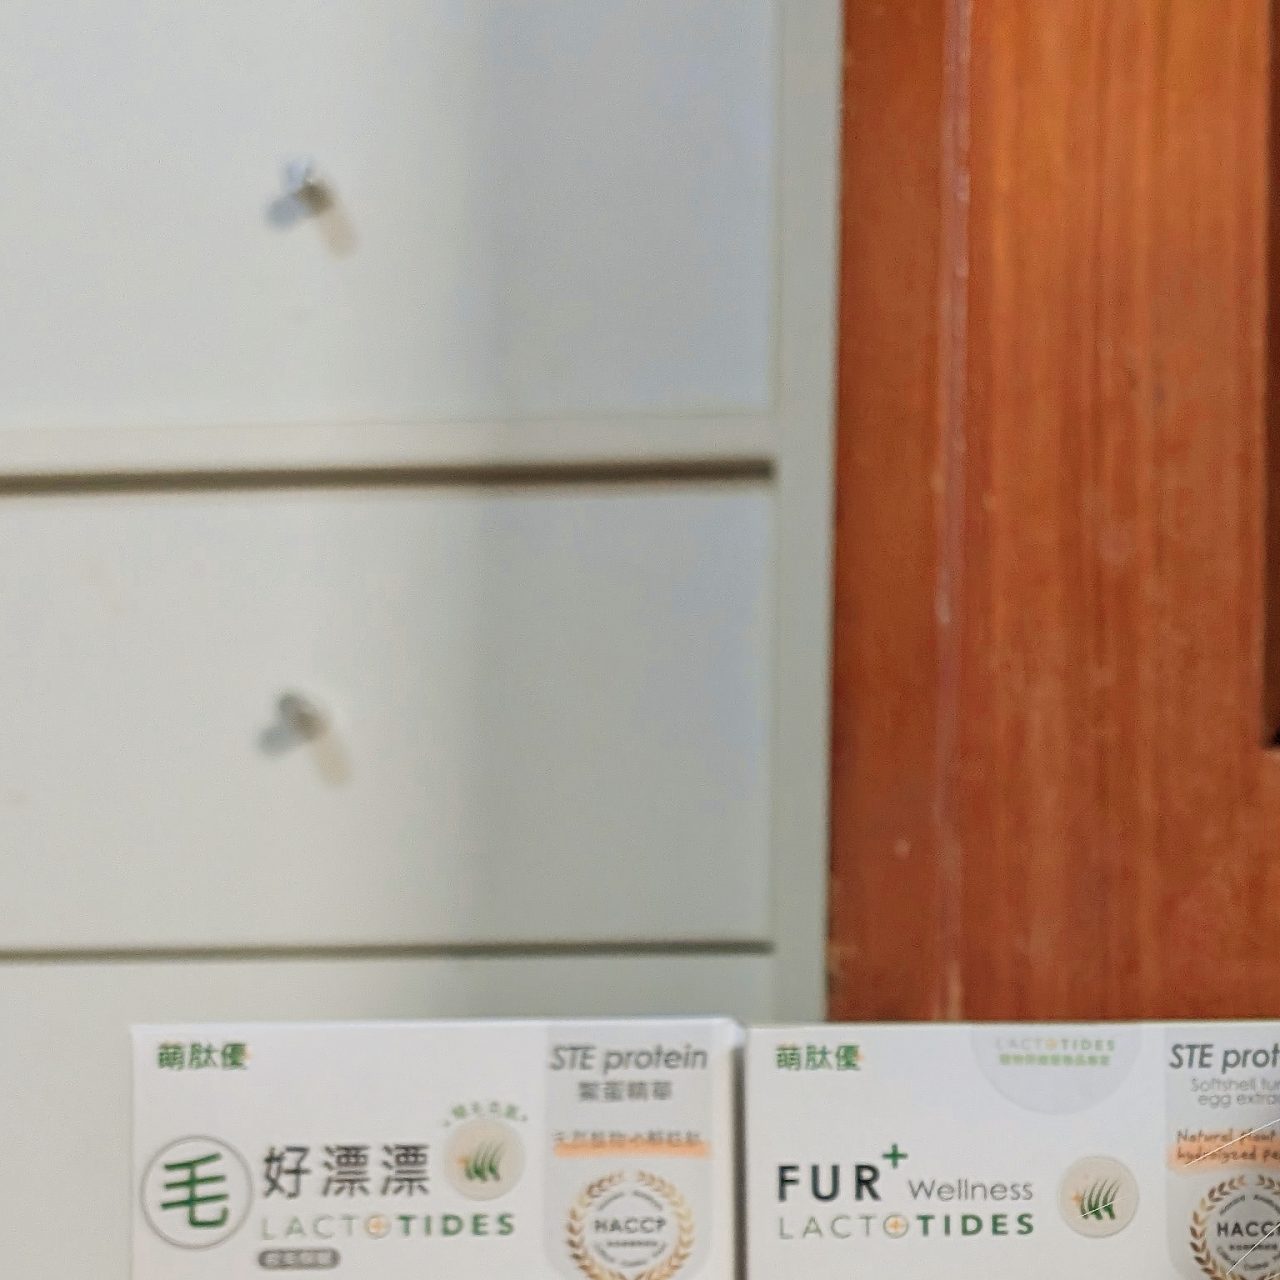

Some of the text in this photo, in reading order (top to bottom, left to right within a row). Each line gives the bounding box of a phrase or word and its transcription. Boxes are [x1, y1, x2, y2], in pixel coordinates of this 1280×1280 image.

[550, 1045, 708, 1074] STE protein
[776, 1044, 861, 1071] 萌肽優
[1169, 1044, 1213, 1069] STE
[1198, 1094, 1231, 1108] egg
[160, 1145, 431, 1228] 毛 好漂漂
[908, 1179, 1033, 1201] Wellness
[261, 1213, 515, 1239] LACTOTIDES
[779, 1213, 1034, 1239] LACTOTIDES
